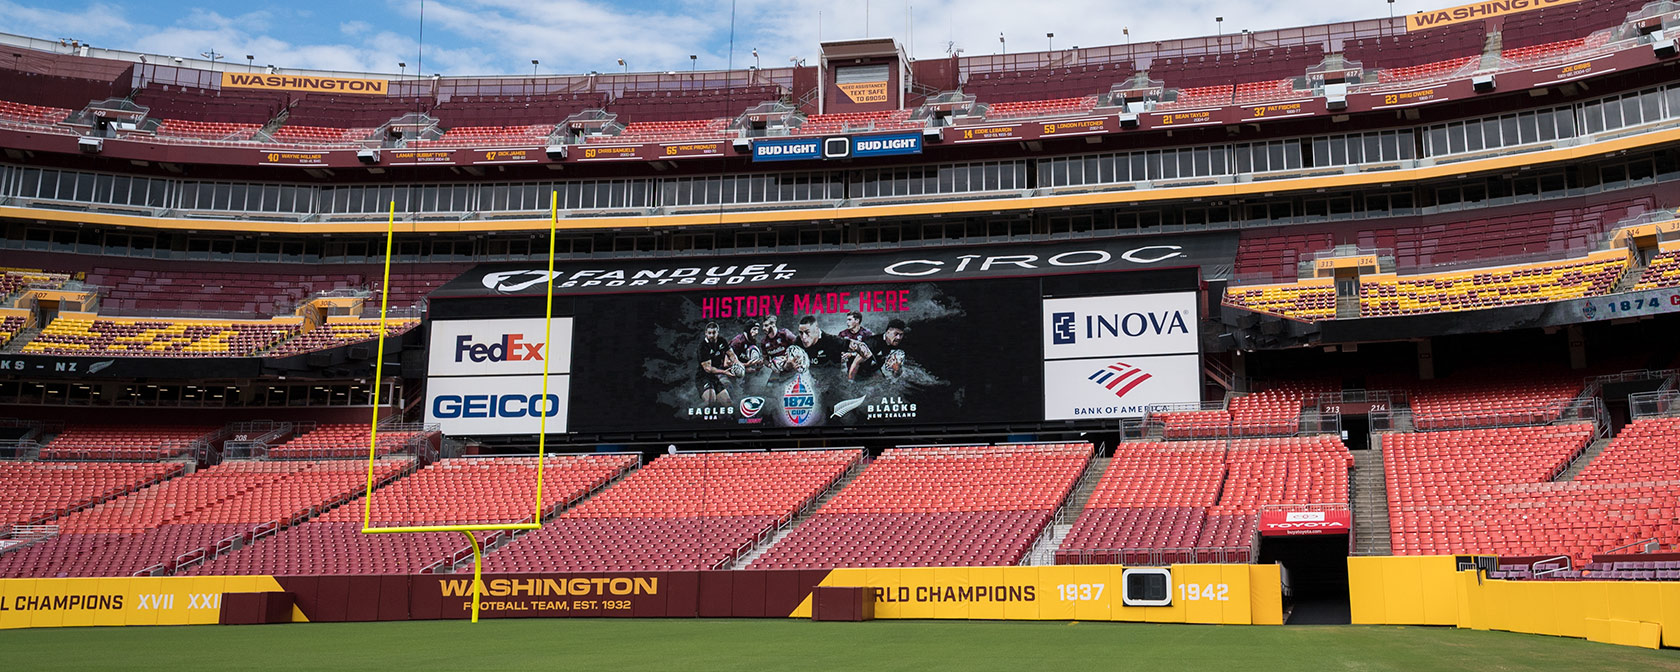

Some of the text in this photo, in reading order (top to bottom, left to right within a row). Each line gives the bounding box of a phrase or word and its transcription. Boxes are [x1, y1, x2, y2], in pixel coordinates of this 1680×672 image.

[1414, 0, 1556, 27] WASHING
[230, 74, 382, 92] WASHINGTON
[1385, 94, 1398, 104] 23
[1254, 107, 1266, 117] 37
[1163, 115, 1173, 124] 21
[964, 130, 973, 139] 14
[1044, 124, 1056, 134] 59
[758, 144, 817, 156] BUD LIGHT
[857, 138, 917, 151] BUD LIGHT
[486, 151, 497, 160] 47
[585, 149, 596, 158] 60
[666, 146, 677, 155] 65
[268, 153, 279, 162] 40
[568, 263, 797, 280] FANDUEL
[558, 272, 795, 288] SPORTSBOOK
[702, 290, 910, 319] HISTORY MADE HERE
[1608, 297, 1660, 313] 1874
[454, 333, 545, 363] FedEx
[55, 362, 77, 372] NZ
[432, 394, 560, 419] GEICO
[784, 396, 814, 407] 1874
[688, 406, 734, 416] EAGLES
[867, 404, 917, 412] BLACKS
[1074, 405, 1168, 415] BANK OF AMERICA
[439, 578, 658, 597] WASHINGTON
[916, 586, 1036, 602] CHAMPIONS
[1057, 584, 1105, 601] 1937
[1178, 583, 1229, 601] 1942
[15, 595, 124, 610] CHAMPIONS
[137, 594, 174, 610] XVII
[463, 600, 631, 612] FOTBALL TEAM, EST. 1932
